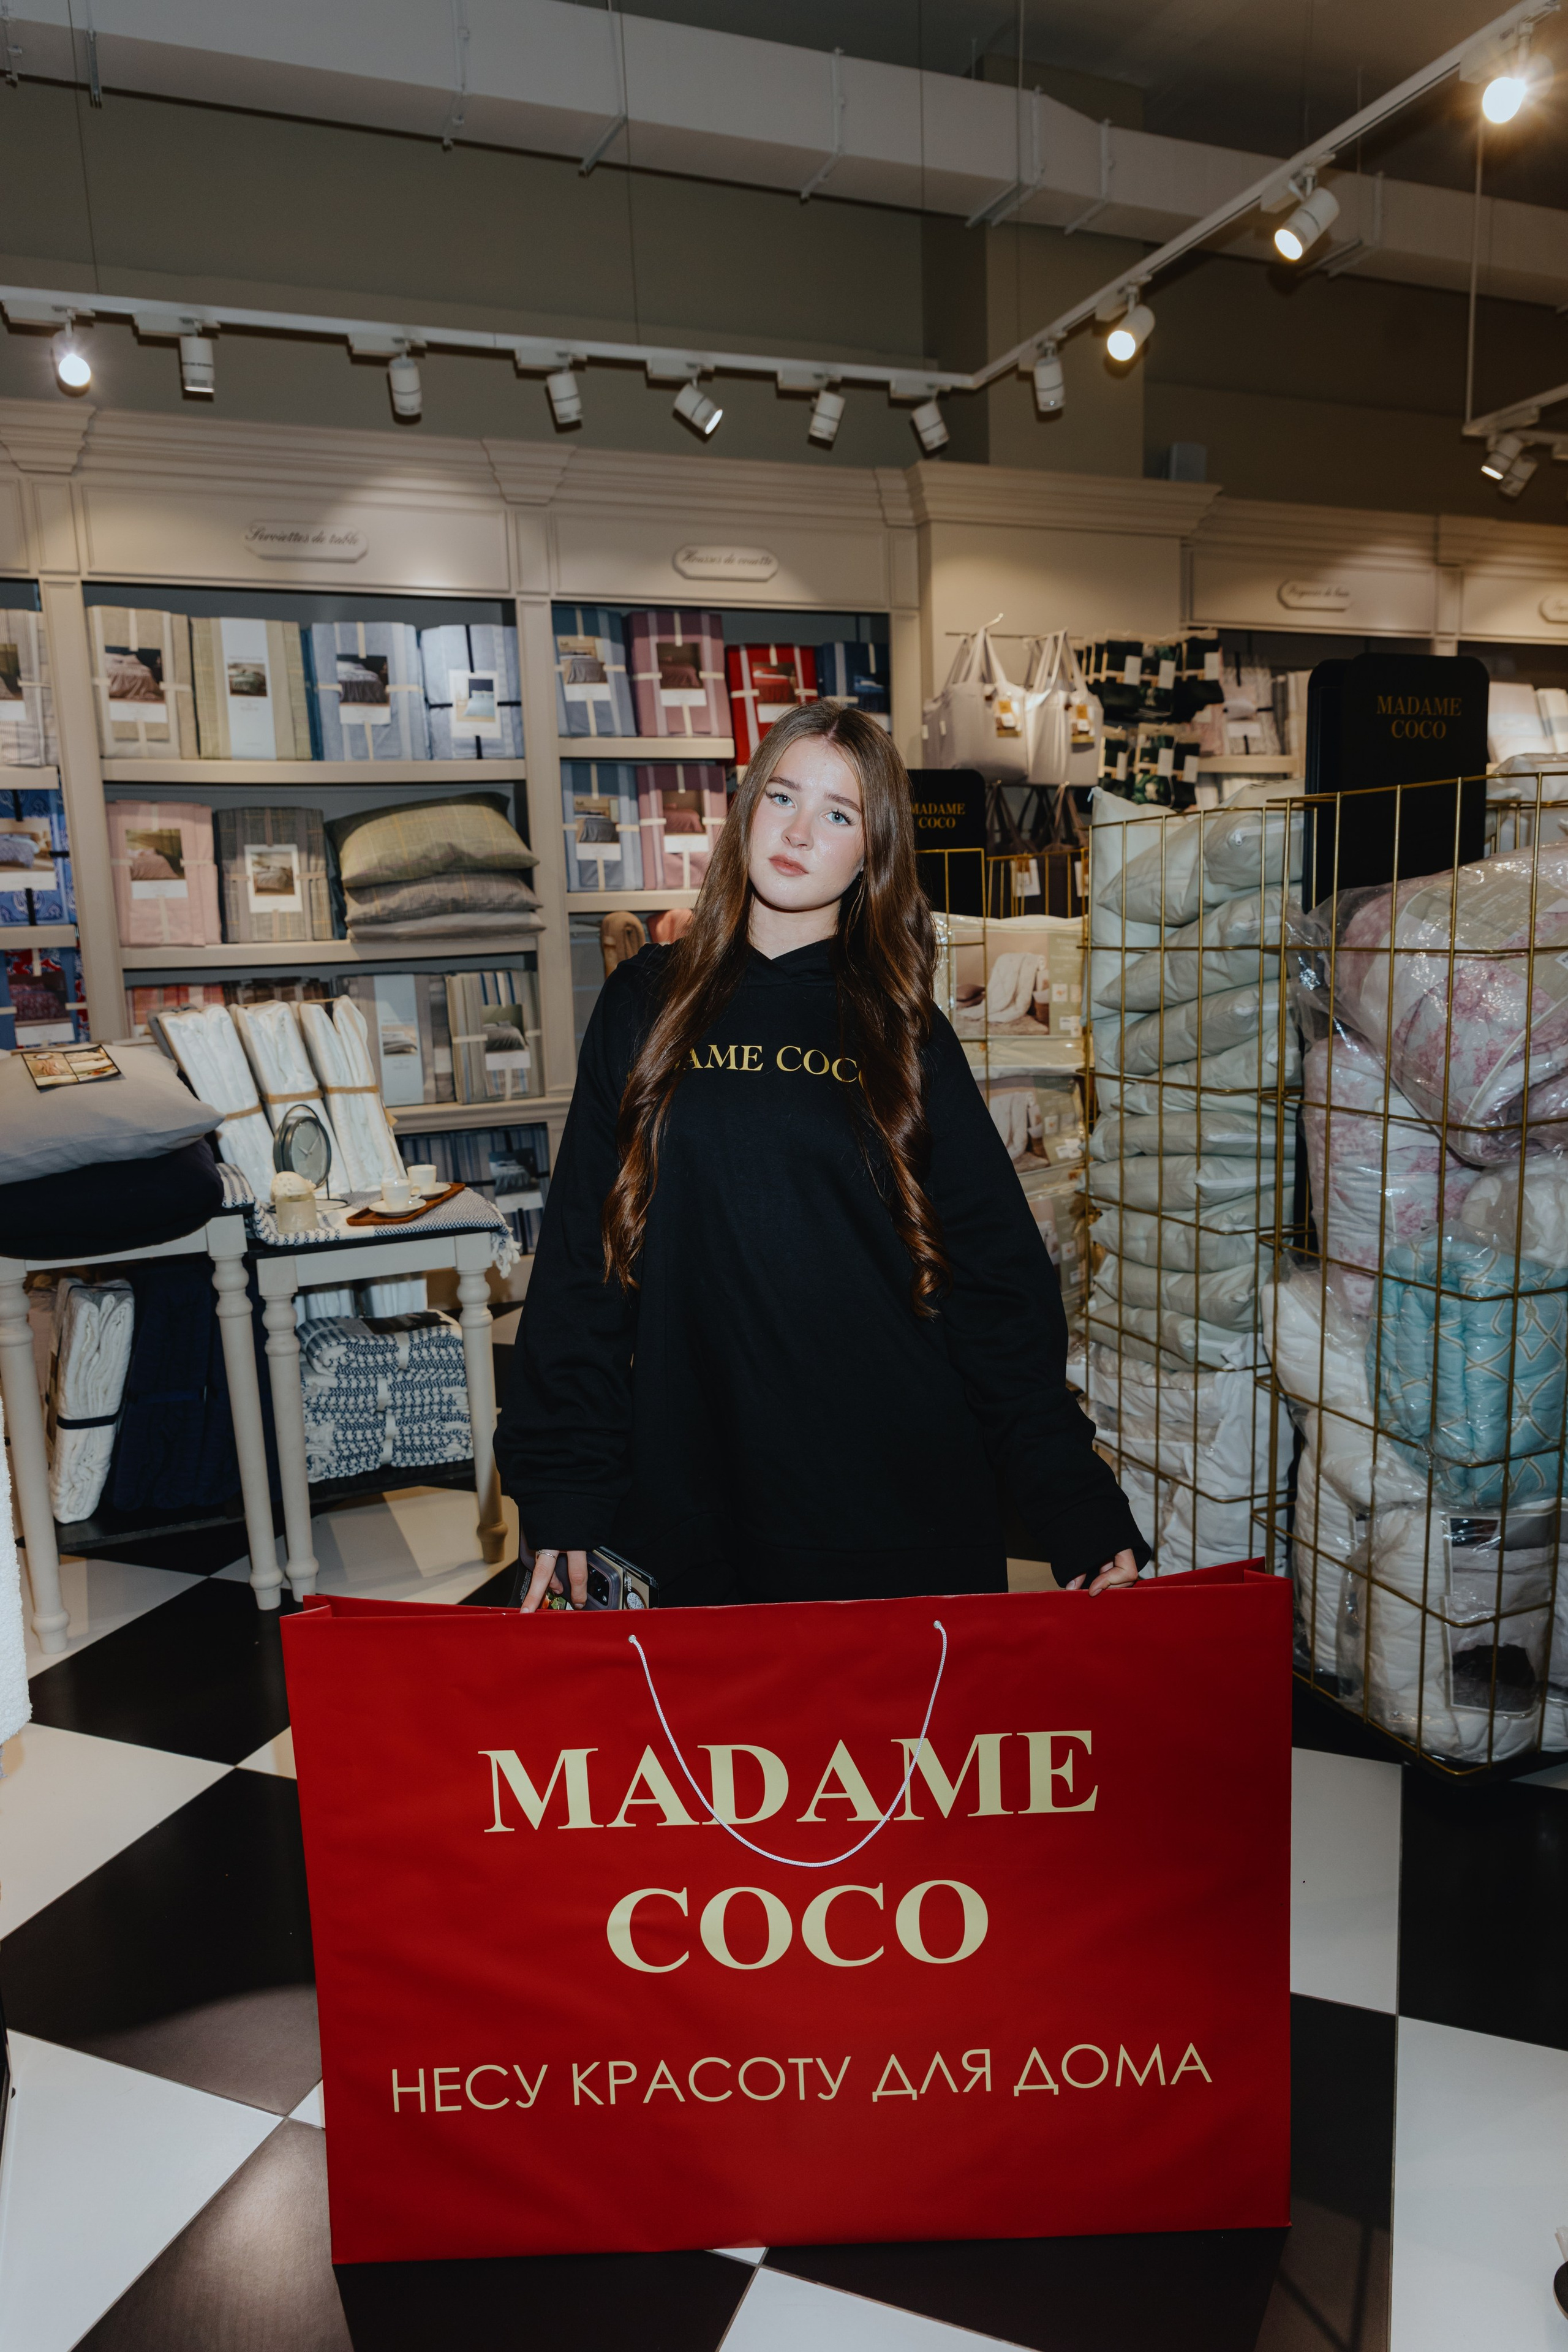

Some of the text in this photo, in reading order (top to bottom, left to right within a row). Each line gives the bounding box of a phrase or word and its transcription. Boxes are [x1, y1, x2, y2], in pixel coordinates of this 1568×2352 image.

[1376, 695, 1463, 717] MADAME
[1391, 719, 1447, 739] COCO
[910, 802, 965, 815] MADAME
[918, 816, 956, 829] COCO
[674, 1044, 865, 1089] AME COC
[478, 1730, 1099, 1833] MADAME
[606, 1880, 989, 1973] COCO
[392, 2043, 1212, 2113] НЕСУ КРАСОТУ ДЛЯ ДОМА
